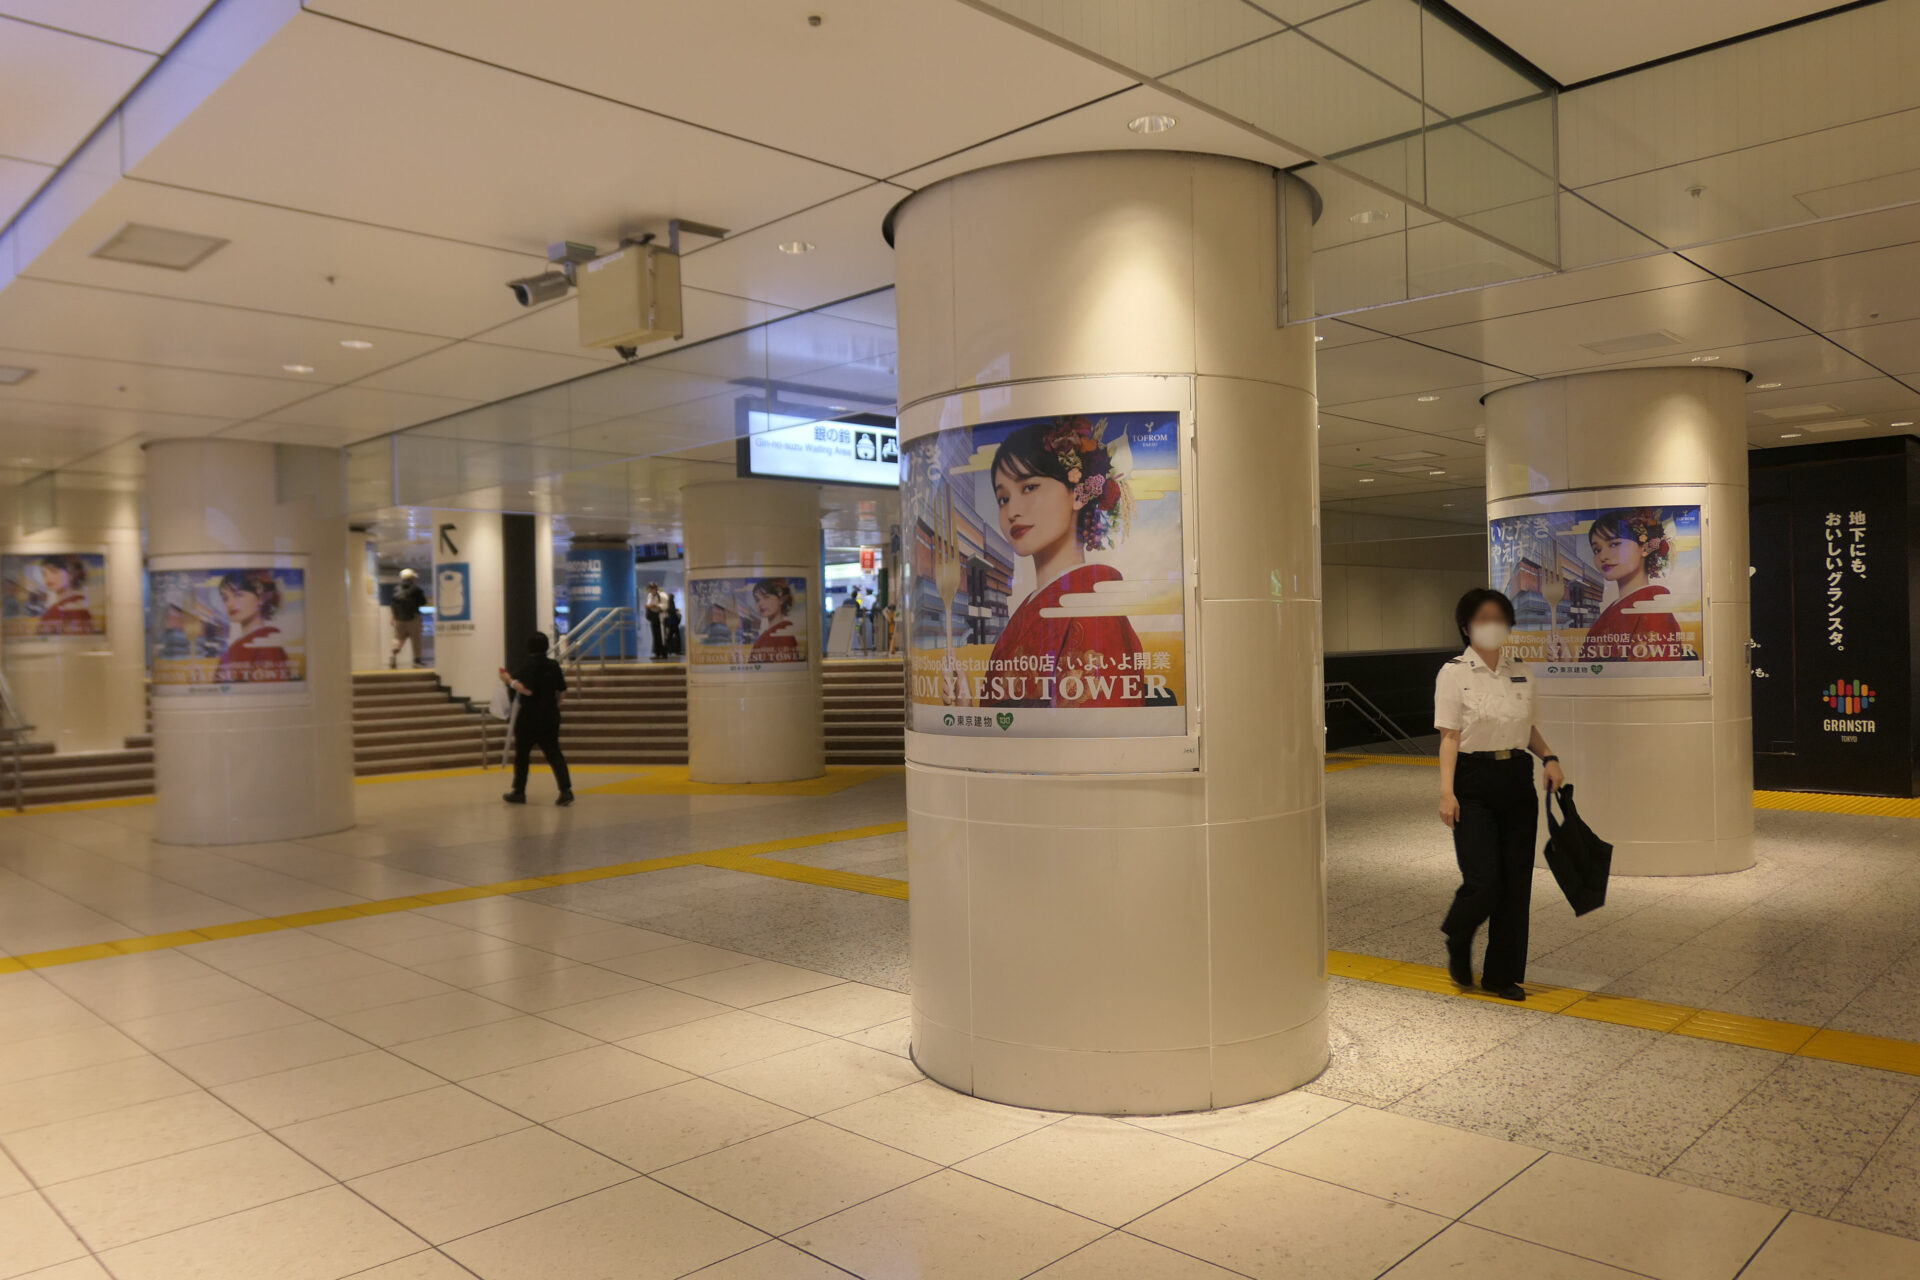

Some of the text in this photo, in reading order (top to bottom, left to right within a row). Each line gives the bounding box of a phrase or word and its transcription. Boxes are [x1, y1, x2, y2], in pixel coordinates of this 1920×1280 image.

[814, 426, 851, 444] 銀の鈴
[1133, 433, 1168, 442] TOFROM
[1848, 511, 1867, 580] 地下にも、
[1825, 512, 1844, 652] おいしいグランスタ。
[1551, 644, 1613, 658] YAESU
[1617, 643, 1696, 658] TOWER
[945, 674, 1027, 701] YAESU
[1034, 674, 1171, 701] TOWER
[957, 714, 993, 728] 東京建物
[1823, 718, 1876, 733] GRANSTA
